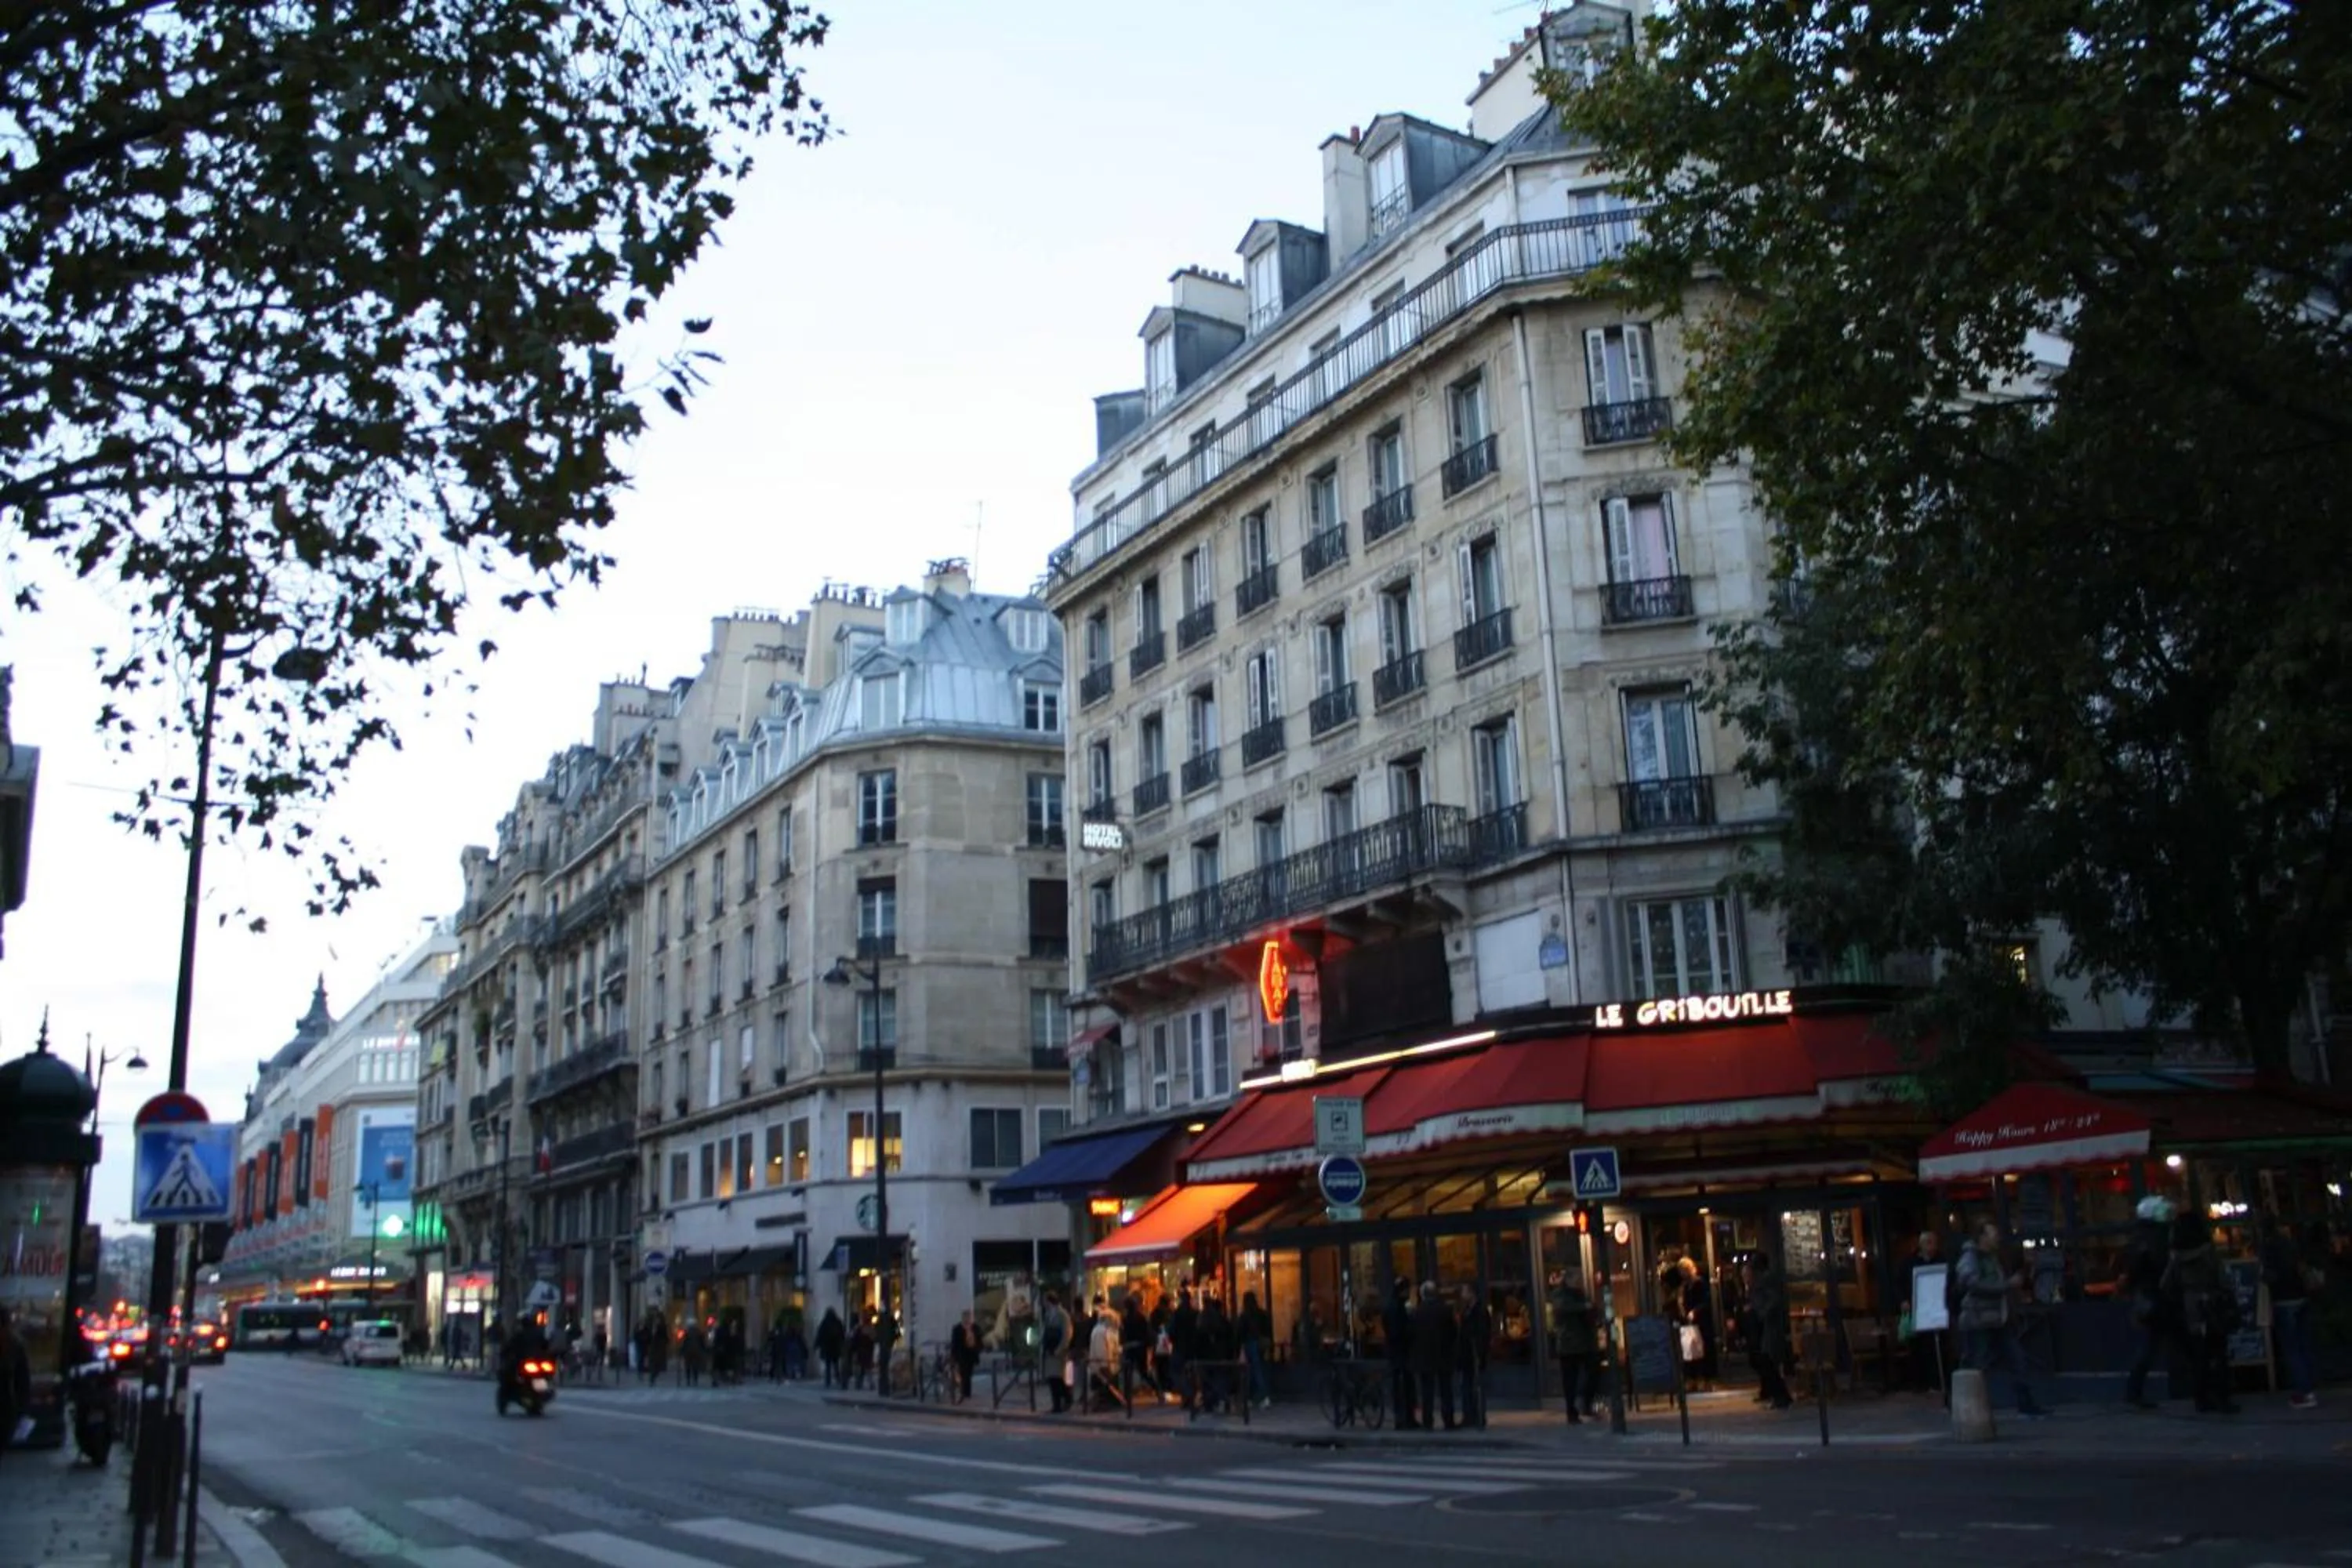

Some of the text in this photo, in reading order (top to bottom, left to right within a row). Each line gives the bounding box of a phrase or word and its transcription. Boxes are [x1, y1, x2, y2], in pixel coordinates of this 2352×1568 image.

[1083, 822, 1120, 836] HOTEL
[1084, 833, 1122, 848] RIVOLI
[1595, 1004, 1624, 1028] LE
[1954, 1128, 1994, 1148] Happy
